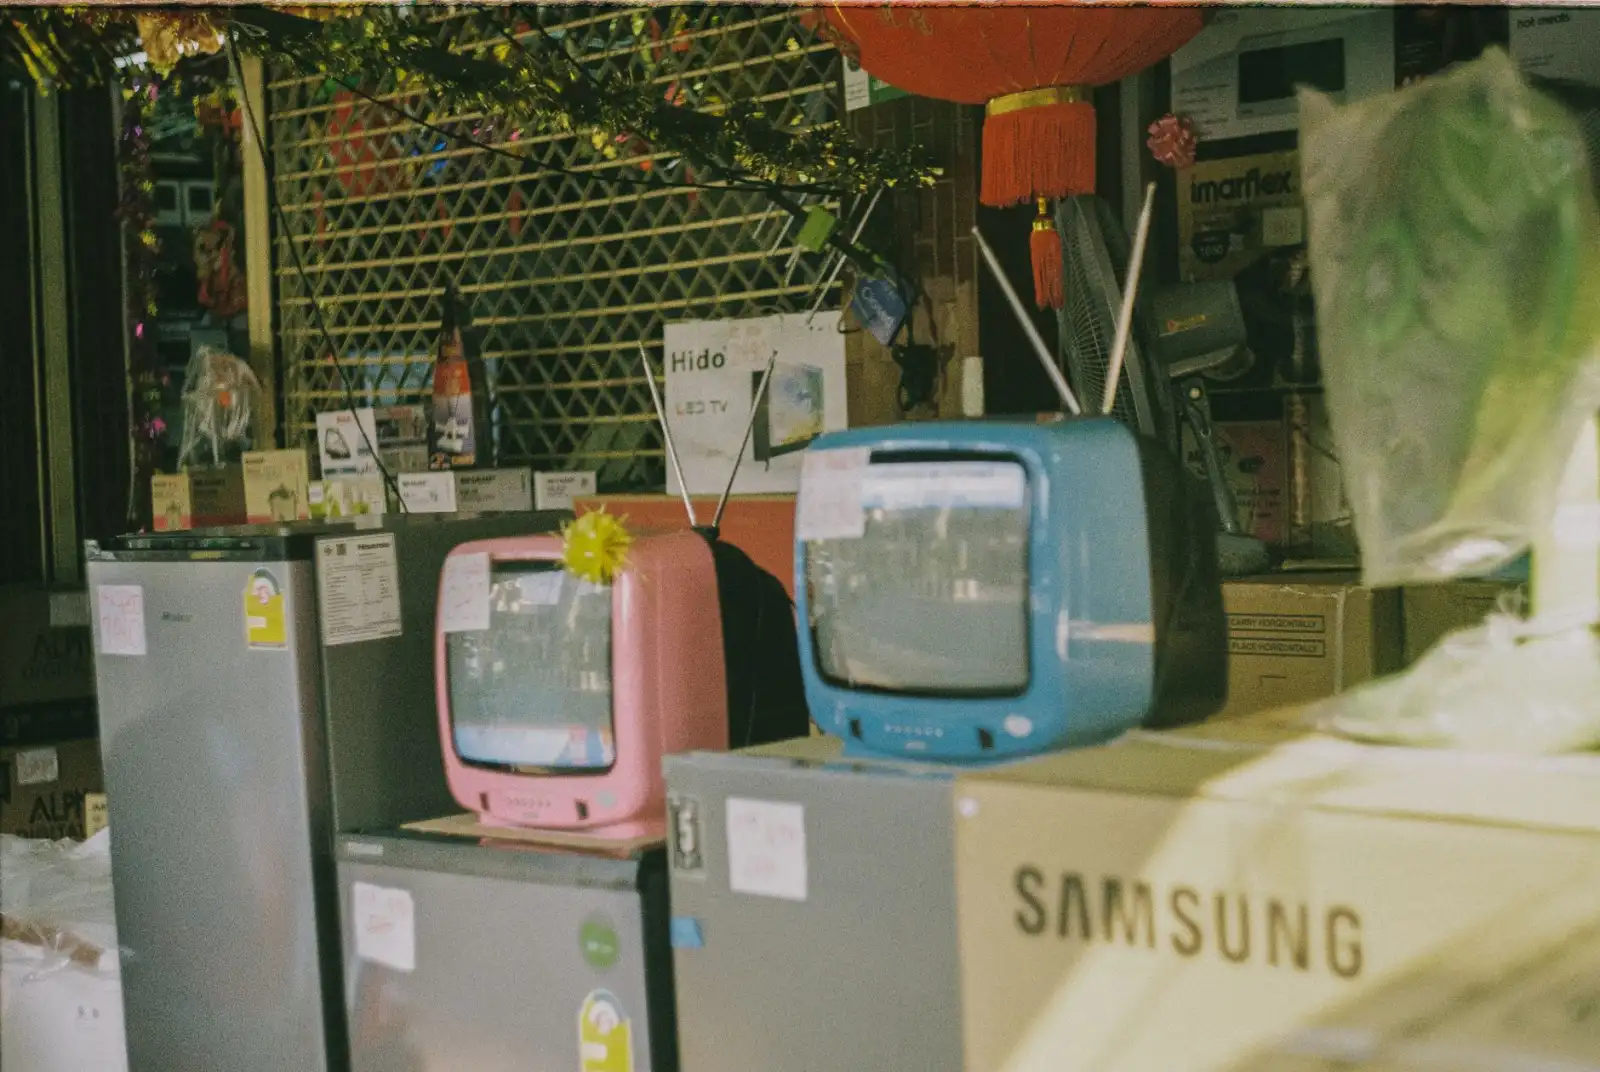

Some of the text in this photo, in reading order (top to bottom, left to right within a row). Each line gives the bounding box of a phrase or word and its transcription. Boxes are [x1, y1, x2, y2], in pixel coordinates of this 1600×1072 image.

[1190, 166, 1292, 203] imarflex
[671, 348, 726, 373] Hido
[709, 401, 729, 416] TV
[1012, 864, 1365, 980] SAMSUNG
